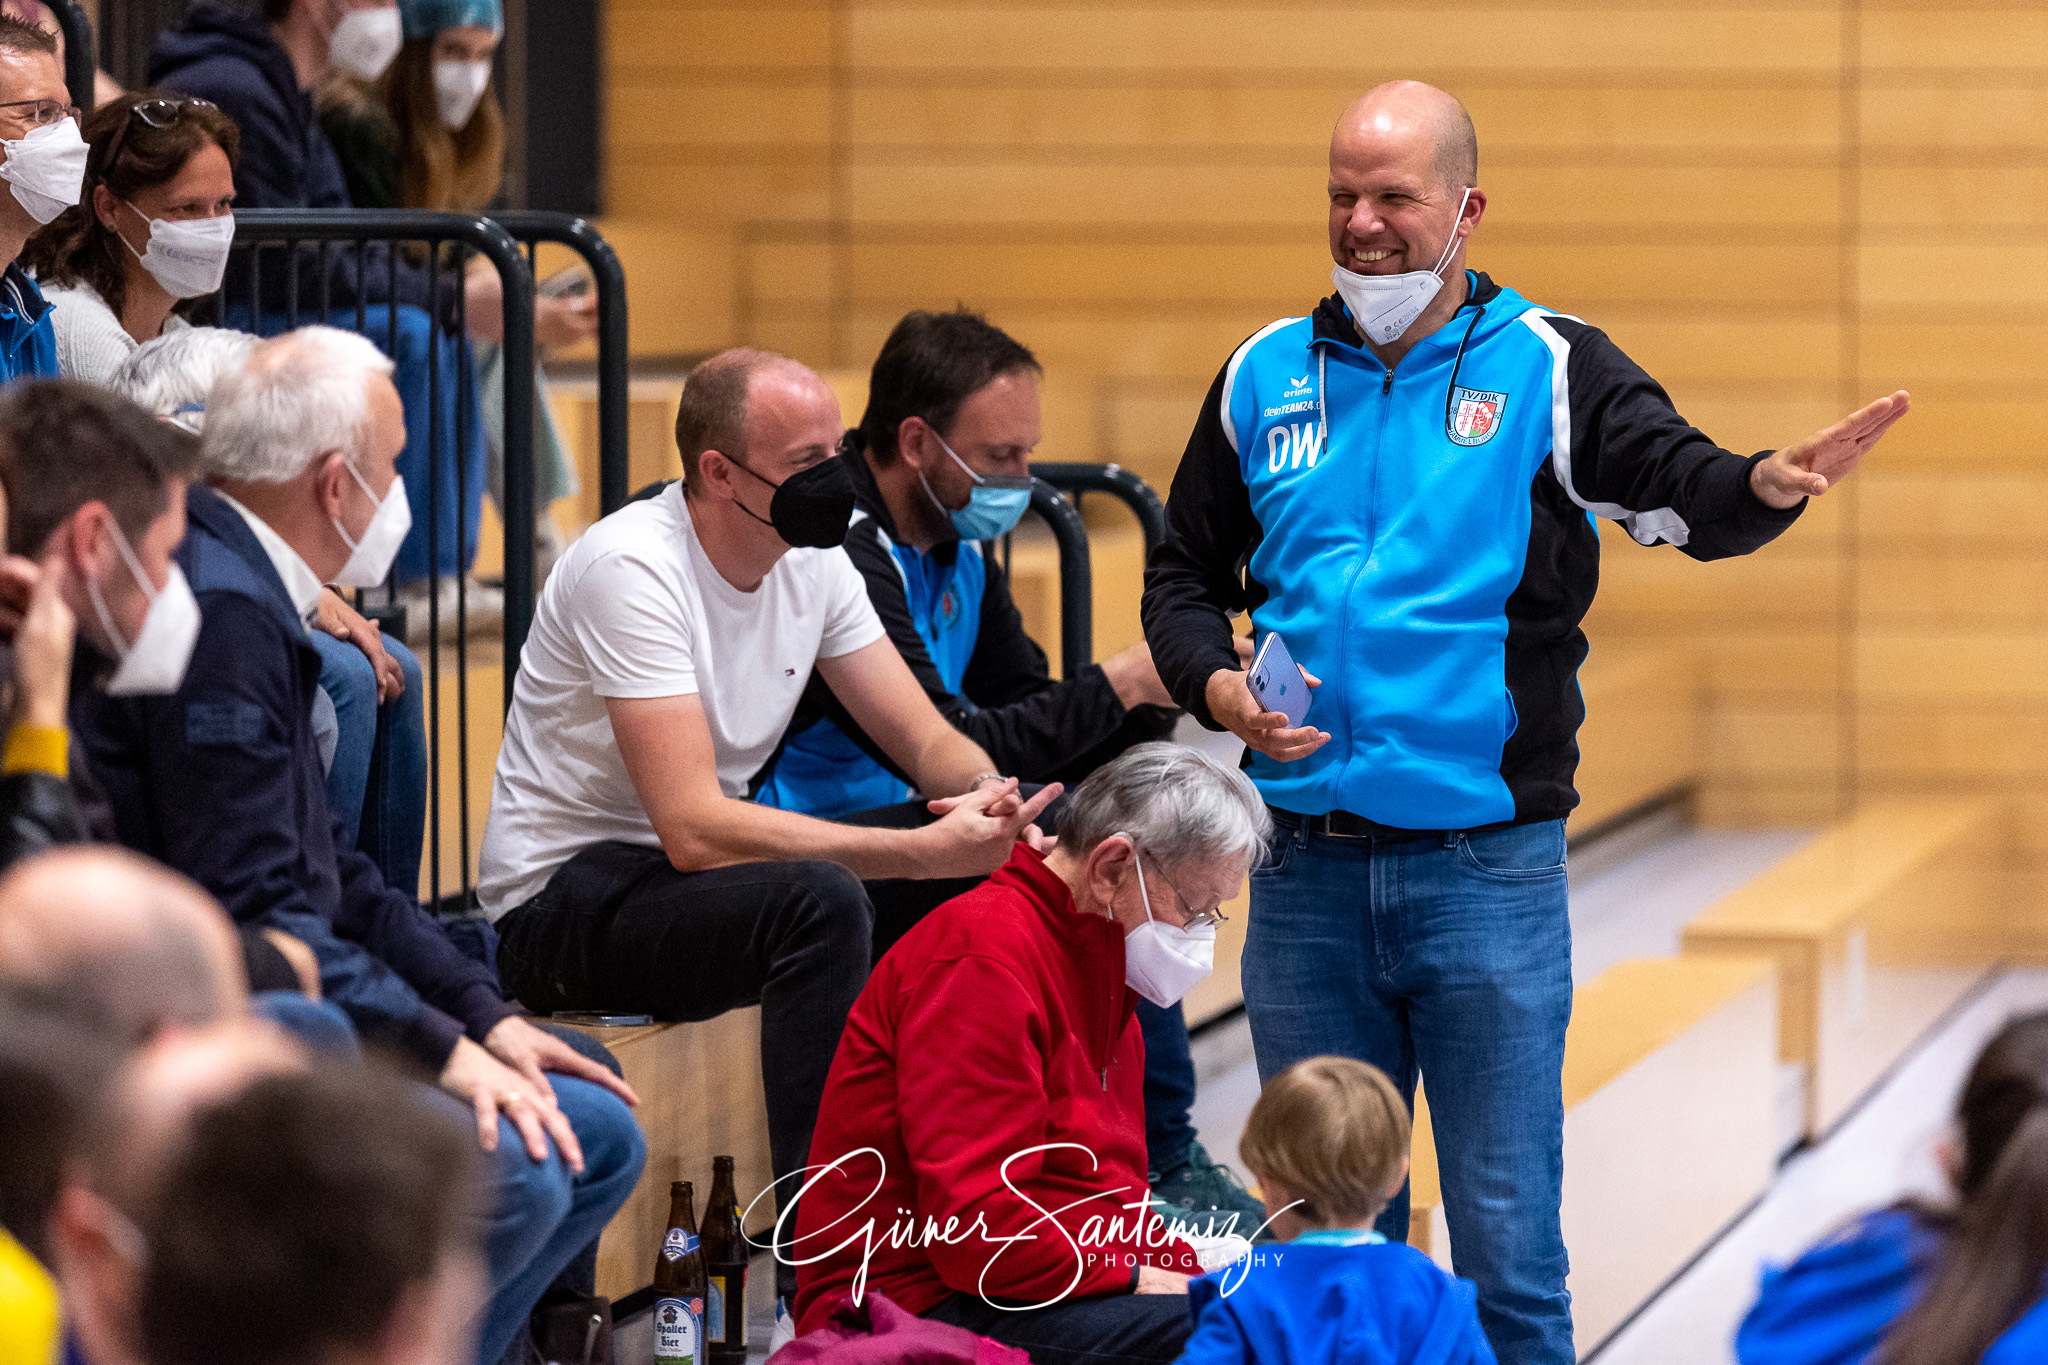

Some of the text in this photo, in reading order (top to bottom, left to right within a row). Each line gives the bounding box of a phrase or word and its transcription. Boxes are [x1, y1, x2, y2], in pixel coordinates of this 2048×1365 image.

[1284, 387, 1313, 398] erima
[1461, 389, 1499, 402] TV/DJK
[1267, 422, 1324, 474] OW
[656, 1321, 687, 1335] Spalter
[661, 1335, 680, 1347] Bier
